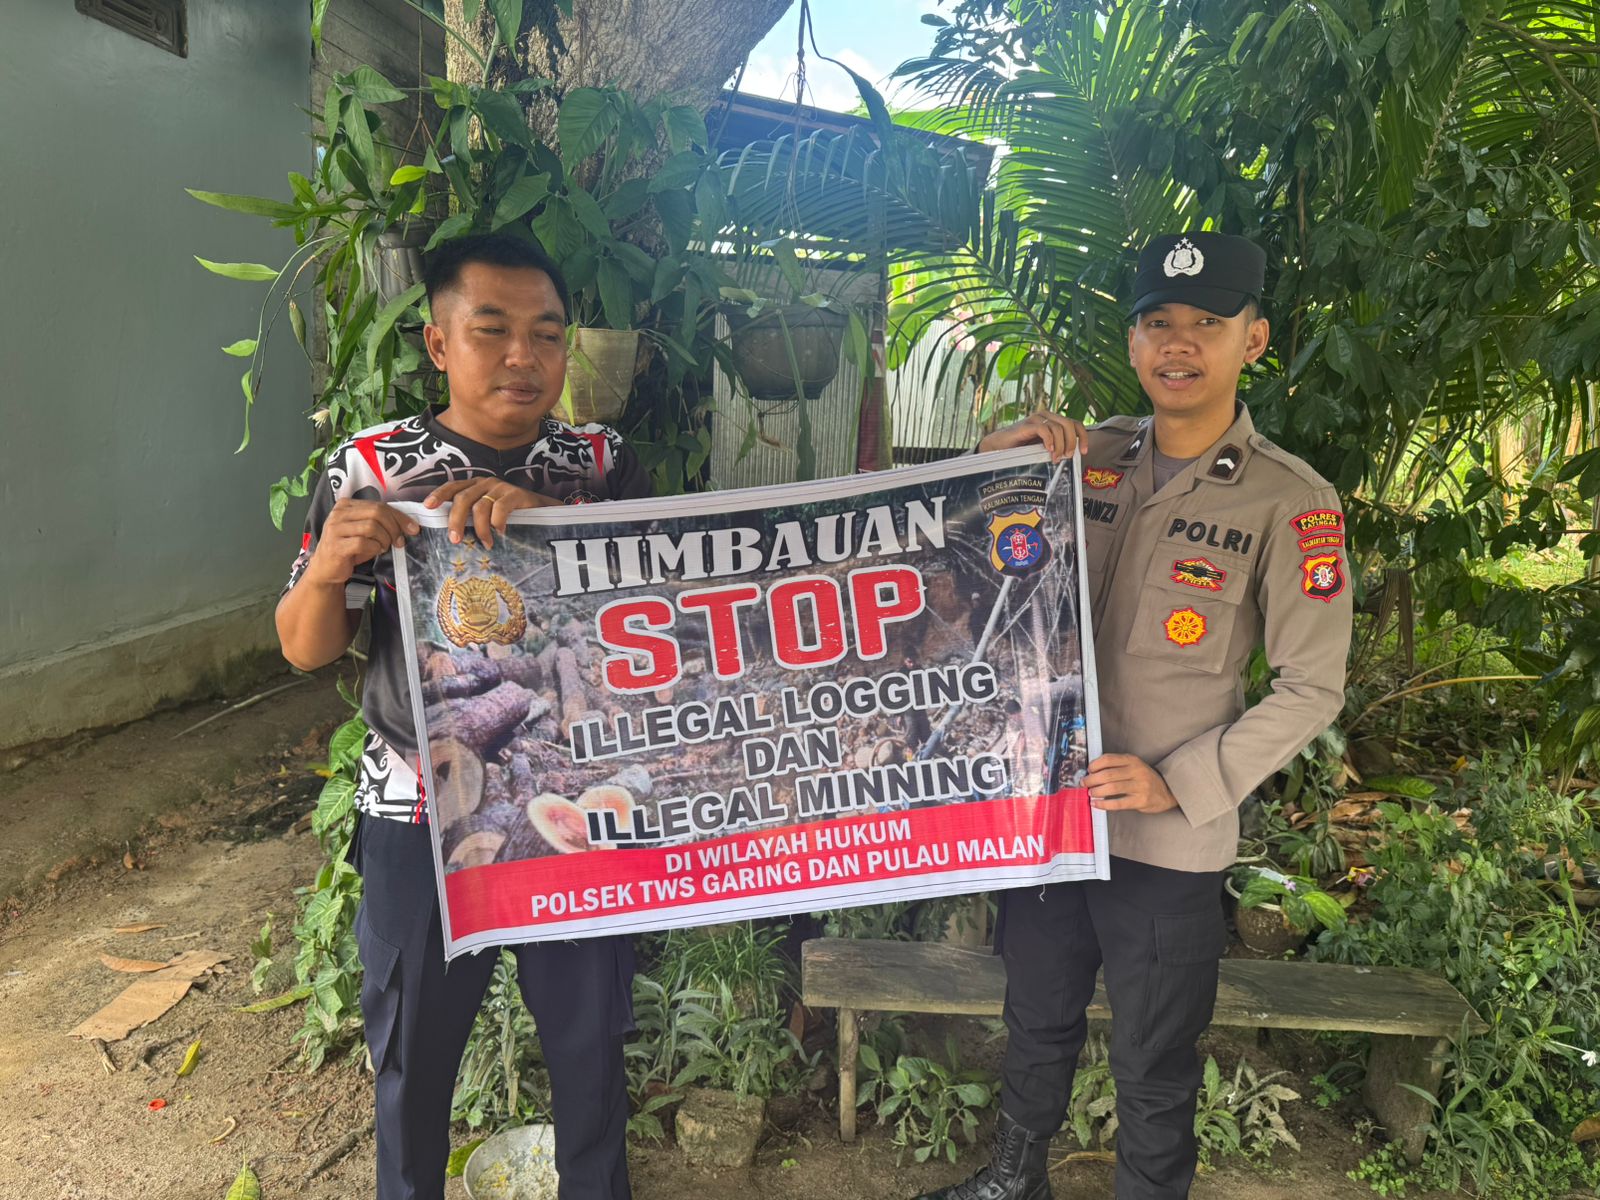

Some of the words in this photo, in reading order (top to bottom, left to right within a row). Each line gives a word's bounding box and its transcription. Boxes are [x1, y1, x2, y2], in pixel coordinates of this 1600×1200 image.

[982, 481, 1008, 494] POLRES
[1008, 479, 1042, 488] KATINGAN
[983, 495, 1019, 511] KALIMANTAN
[1020, 494, 1045, 503] TENGAH
[1167, 518, 1253, 555] POLRI
[1300, 513, 1337, 525] POLRES
[1301, 520, 1338, 531] KATINGAN
[549, 496, 947, 596] HIMBAUAN
[595, 564, 927, 695] STOP
[570, 694, 773, 761] ILLEGAL
[783, 662, 997, 727] LOGGING
[742, 728, 841, 779] DAN
[586, 783, 787, 844] ILLEGAL
[796, 753, 1007, 817] MINNING
[665, 854, 691, 874] DI
[697, 832, 808, 869] WILAYAH
[815, 818, 912, 851] HUKUM
[531, 883, 635, 918] POLSEK
[639, 876, 695, 903] TWS
[702, 861, 801, 894] GARING
[808, 854, 860, 882] DAN
[868, 842, 950, 874] PULAU
[956, 834, 1045, 863] MALAN
